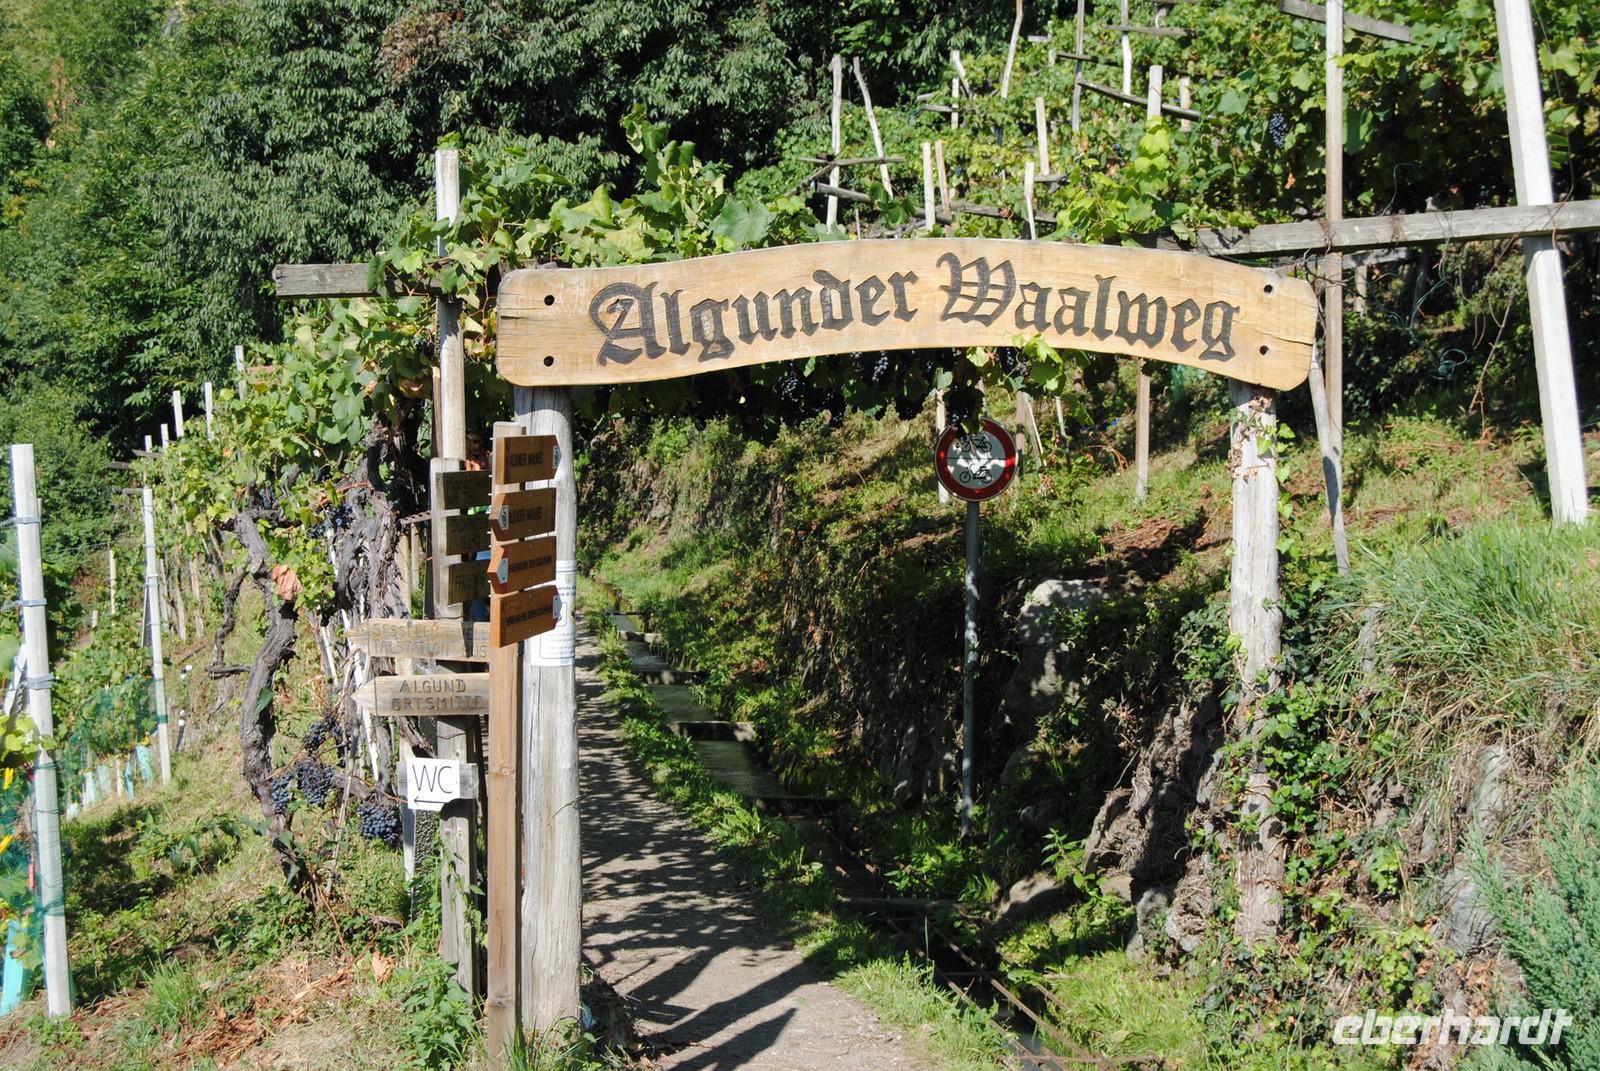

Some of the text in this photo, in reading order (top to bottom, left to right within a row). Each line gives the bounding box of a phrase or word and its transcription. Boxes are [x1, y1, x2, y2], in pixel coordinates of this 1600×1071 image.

[588, 251, 1241, 365] Algunder Waalweg
[399, 679, 467, 694] ALGUND
[391, 695, 483, 712] ORTSMITTE
[411, 764, 453, 794] WC
